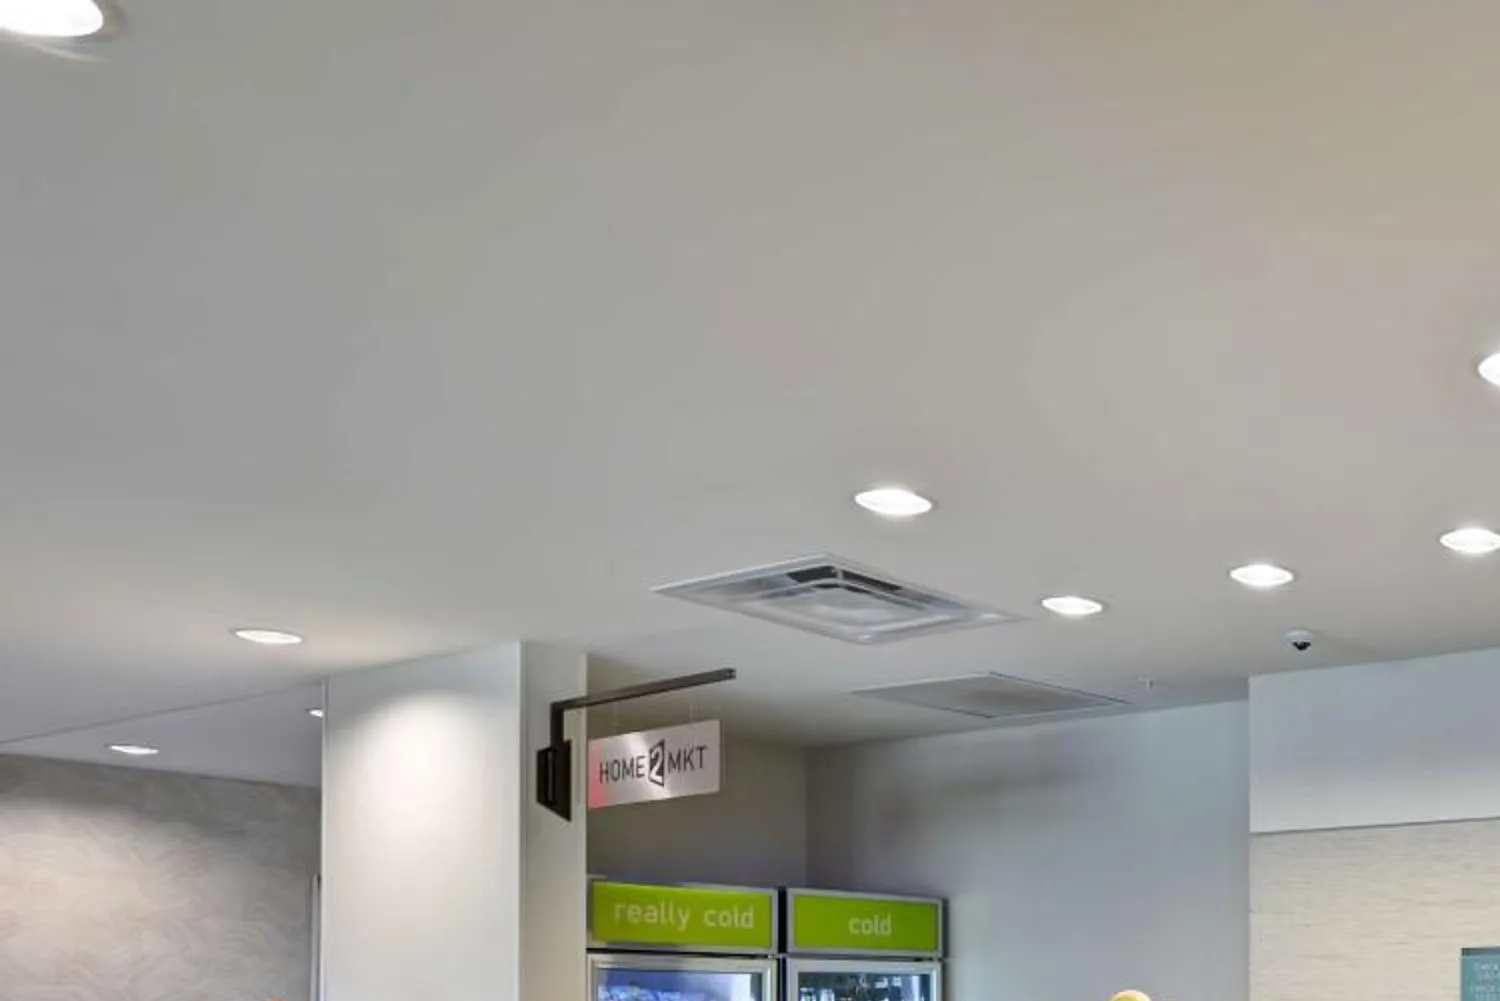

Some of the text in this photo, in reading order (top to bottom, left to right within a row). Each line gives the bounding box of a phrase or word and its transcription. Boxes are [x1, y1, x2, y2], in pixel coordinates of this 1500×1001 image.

[614, 901, 755, 932] really cold
[848, 912, 892, 937] cold
